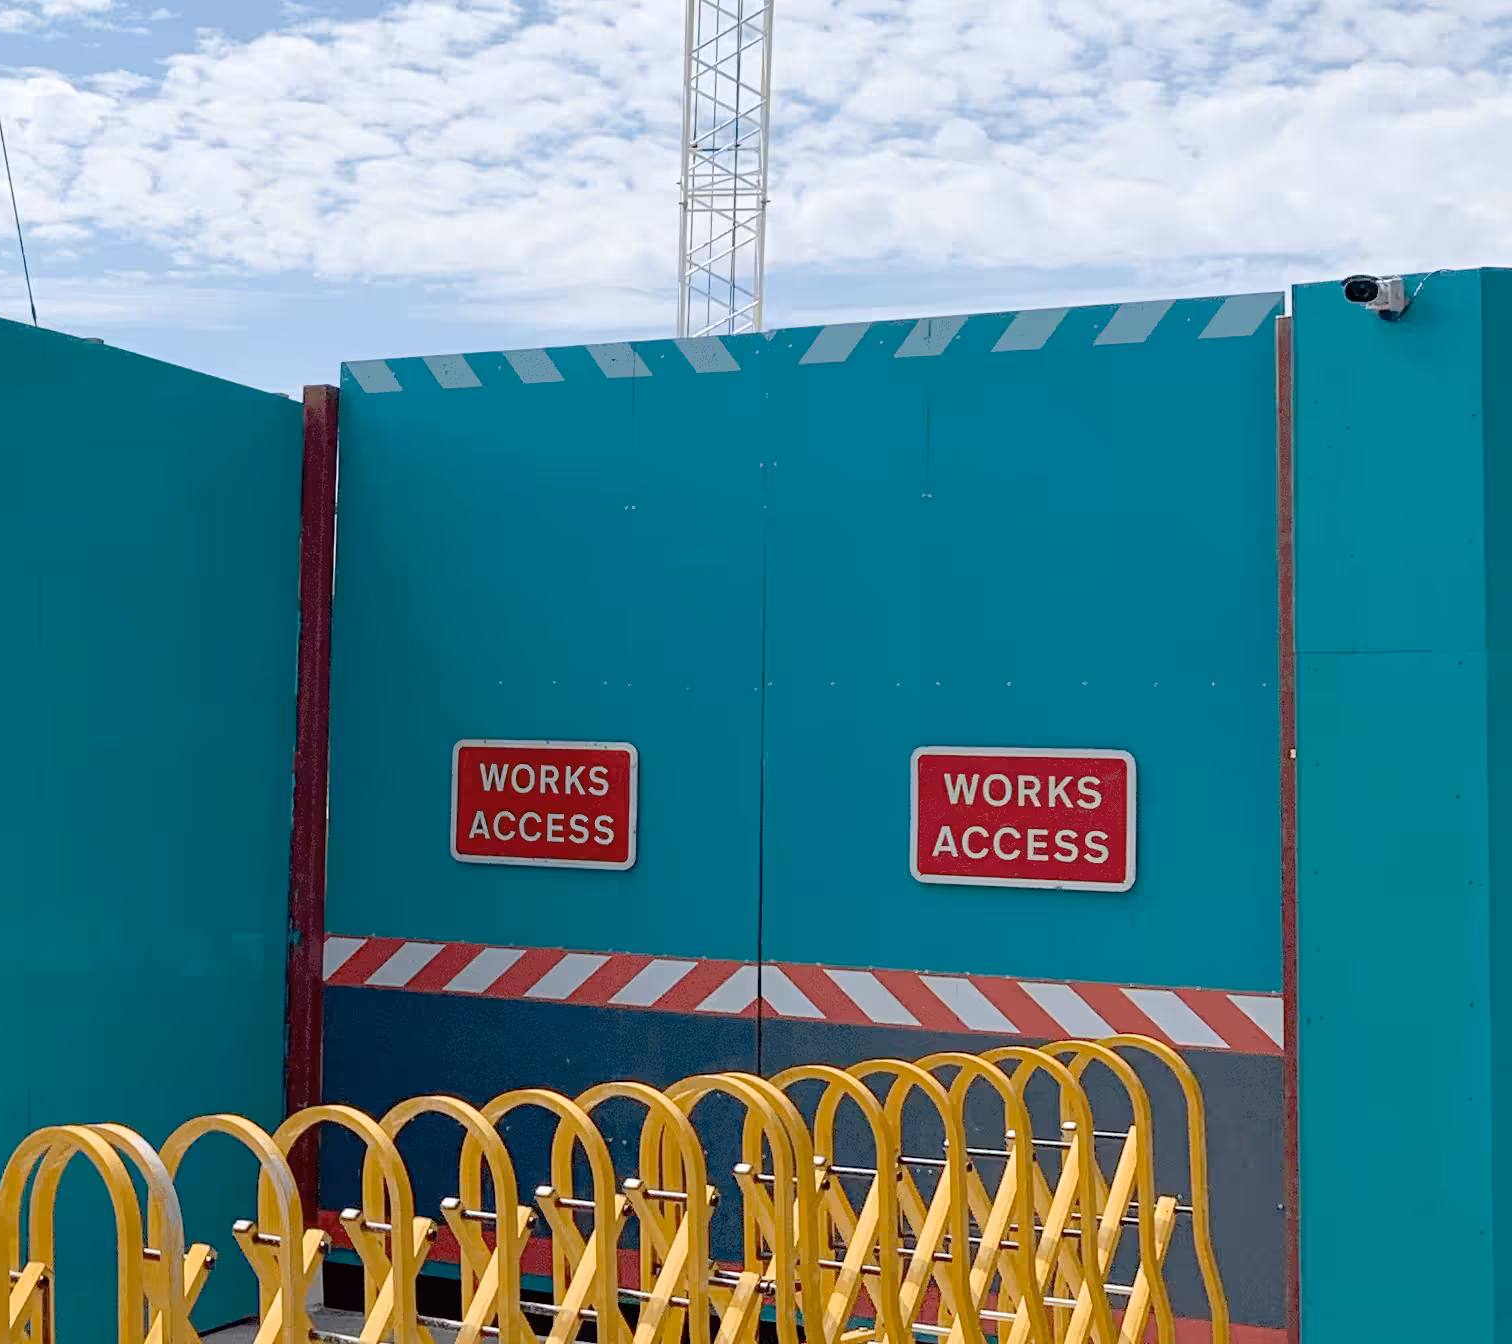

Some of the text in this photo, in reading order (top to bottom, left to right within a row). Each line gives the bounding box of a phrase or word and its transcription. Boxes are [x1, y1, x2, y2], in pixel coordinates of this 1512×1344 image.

[479, 762, 610, 797] WORKS
[943, 772, 1103, 810] WORKS
[468, 809, 615, 846] ACCESS
[931, 824, 1110, 864] ACCESS
